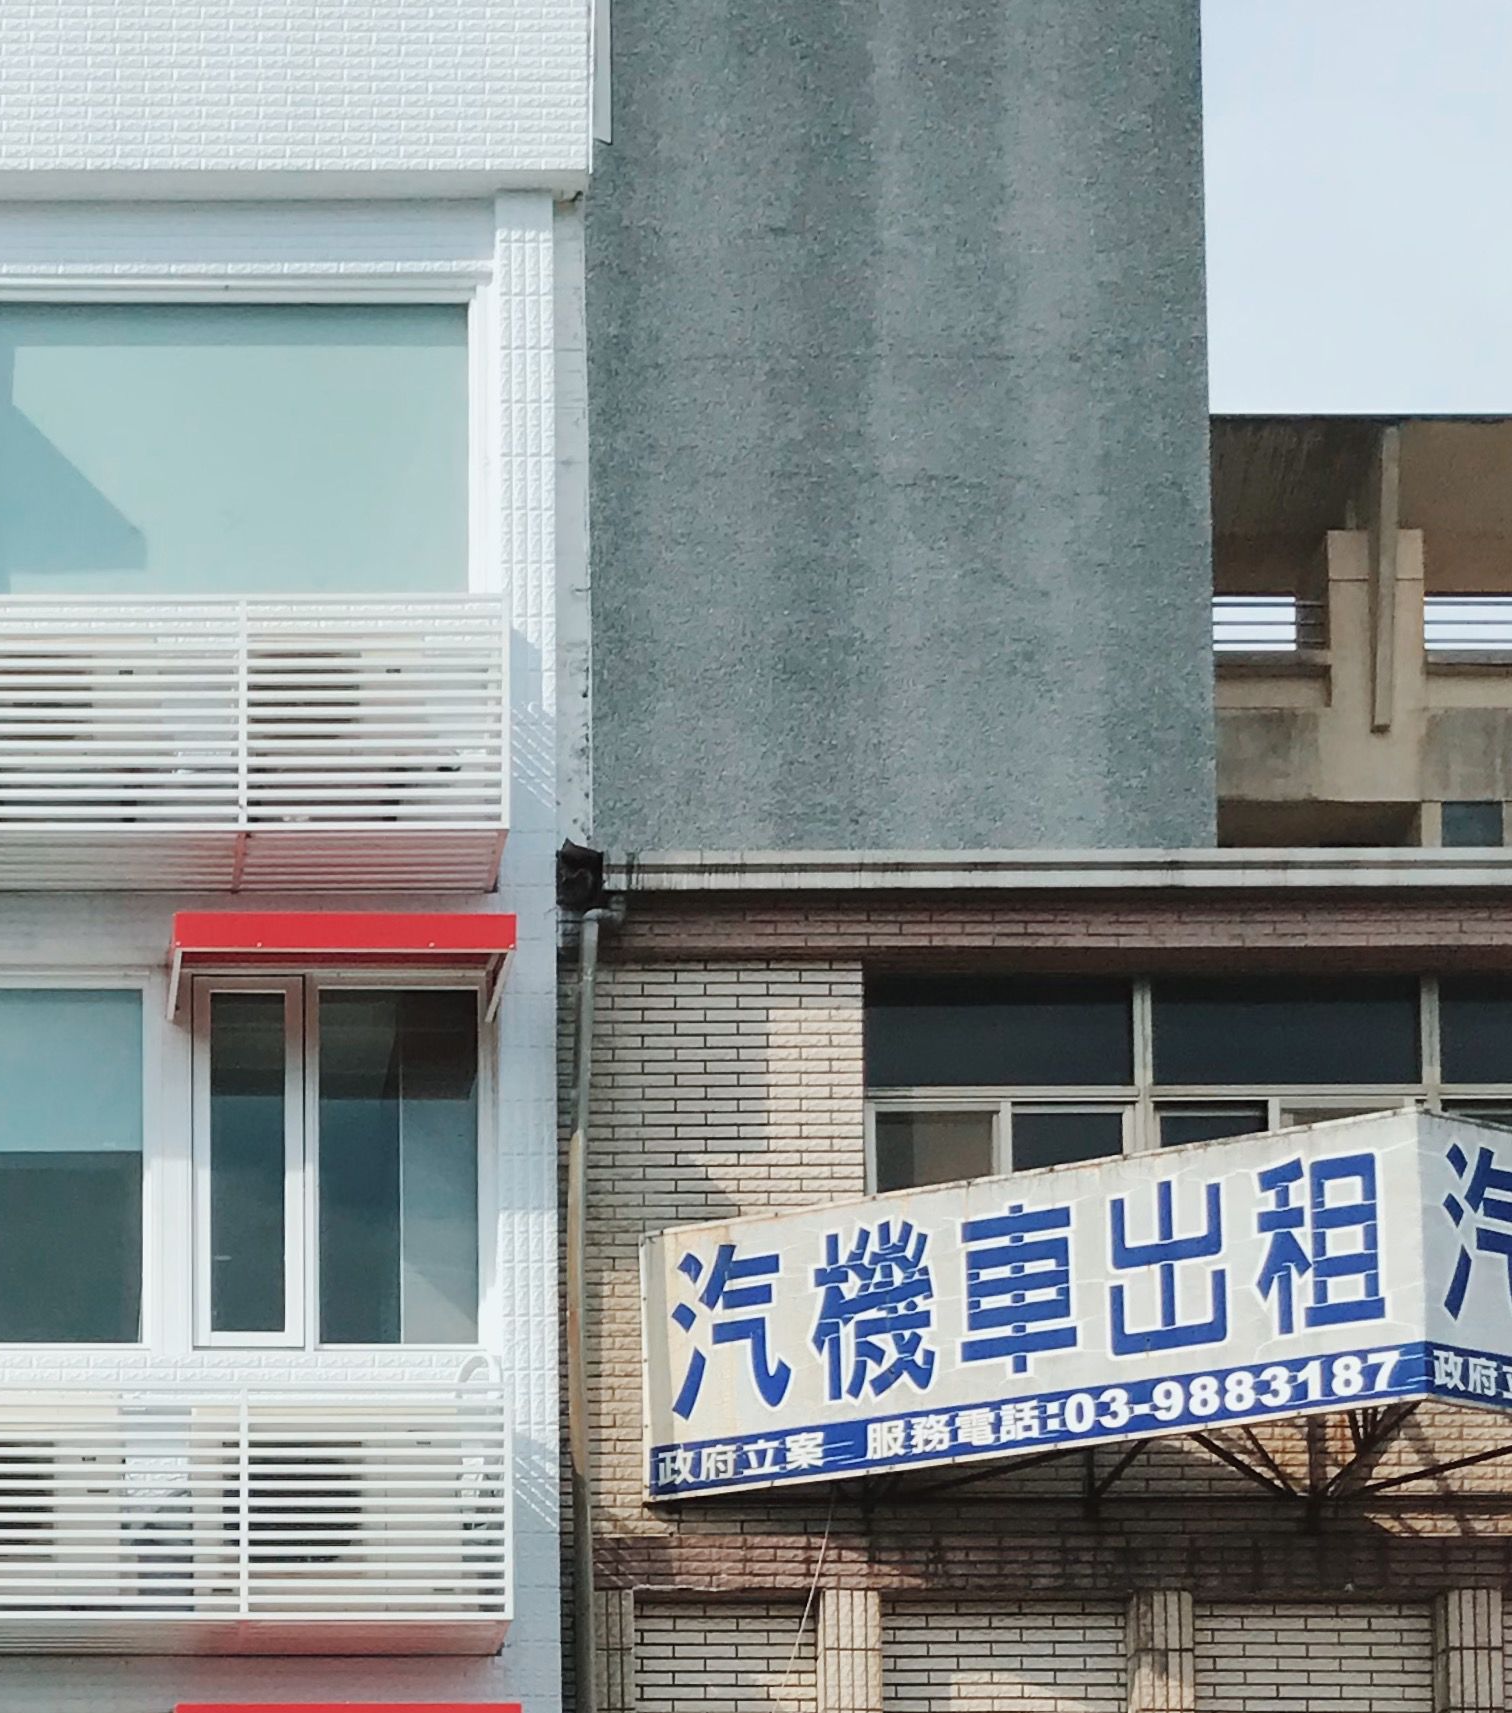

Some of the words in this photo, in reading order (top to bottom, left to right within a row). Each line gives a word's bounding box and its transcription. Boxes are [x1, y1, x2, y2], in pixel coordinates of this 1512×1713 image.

[672, 1152, 1386, 1420] 汽機車出租
[1433, 1350, 1512, 1400] 政府
[657, 1432, 824, 1486] 政府立案
